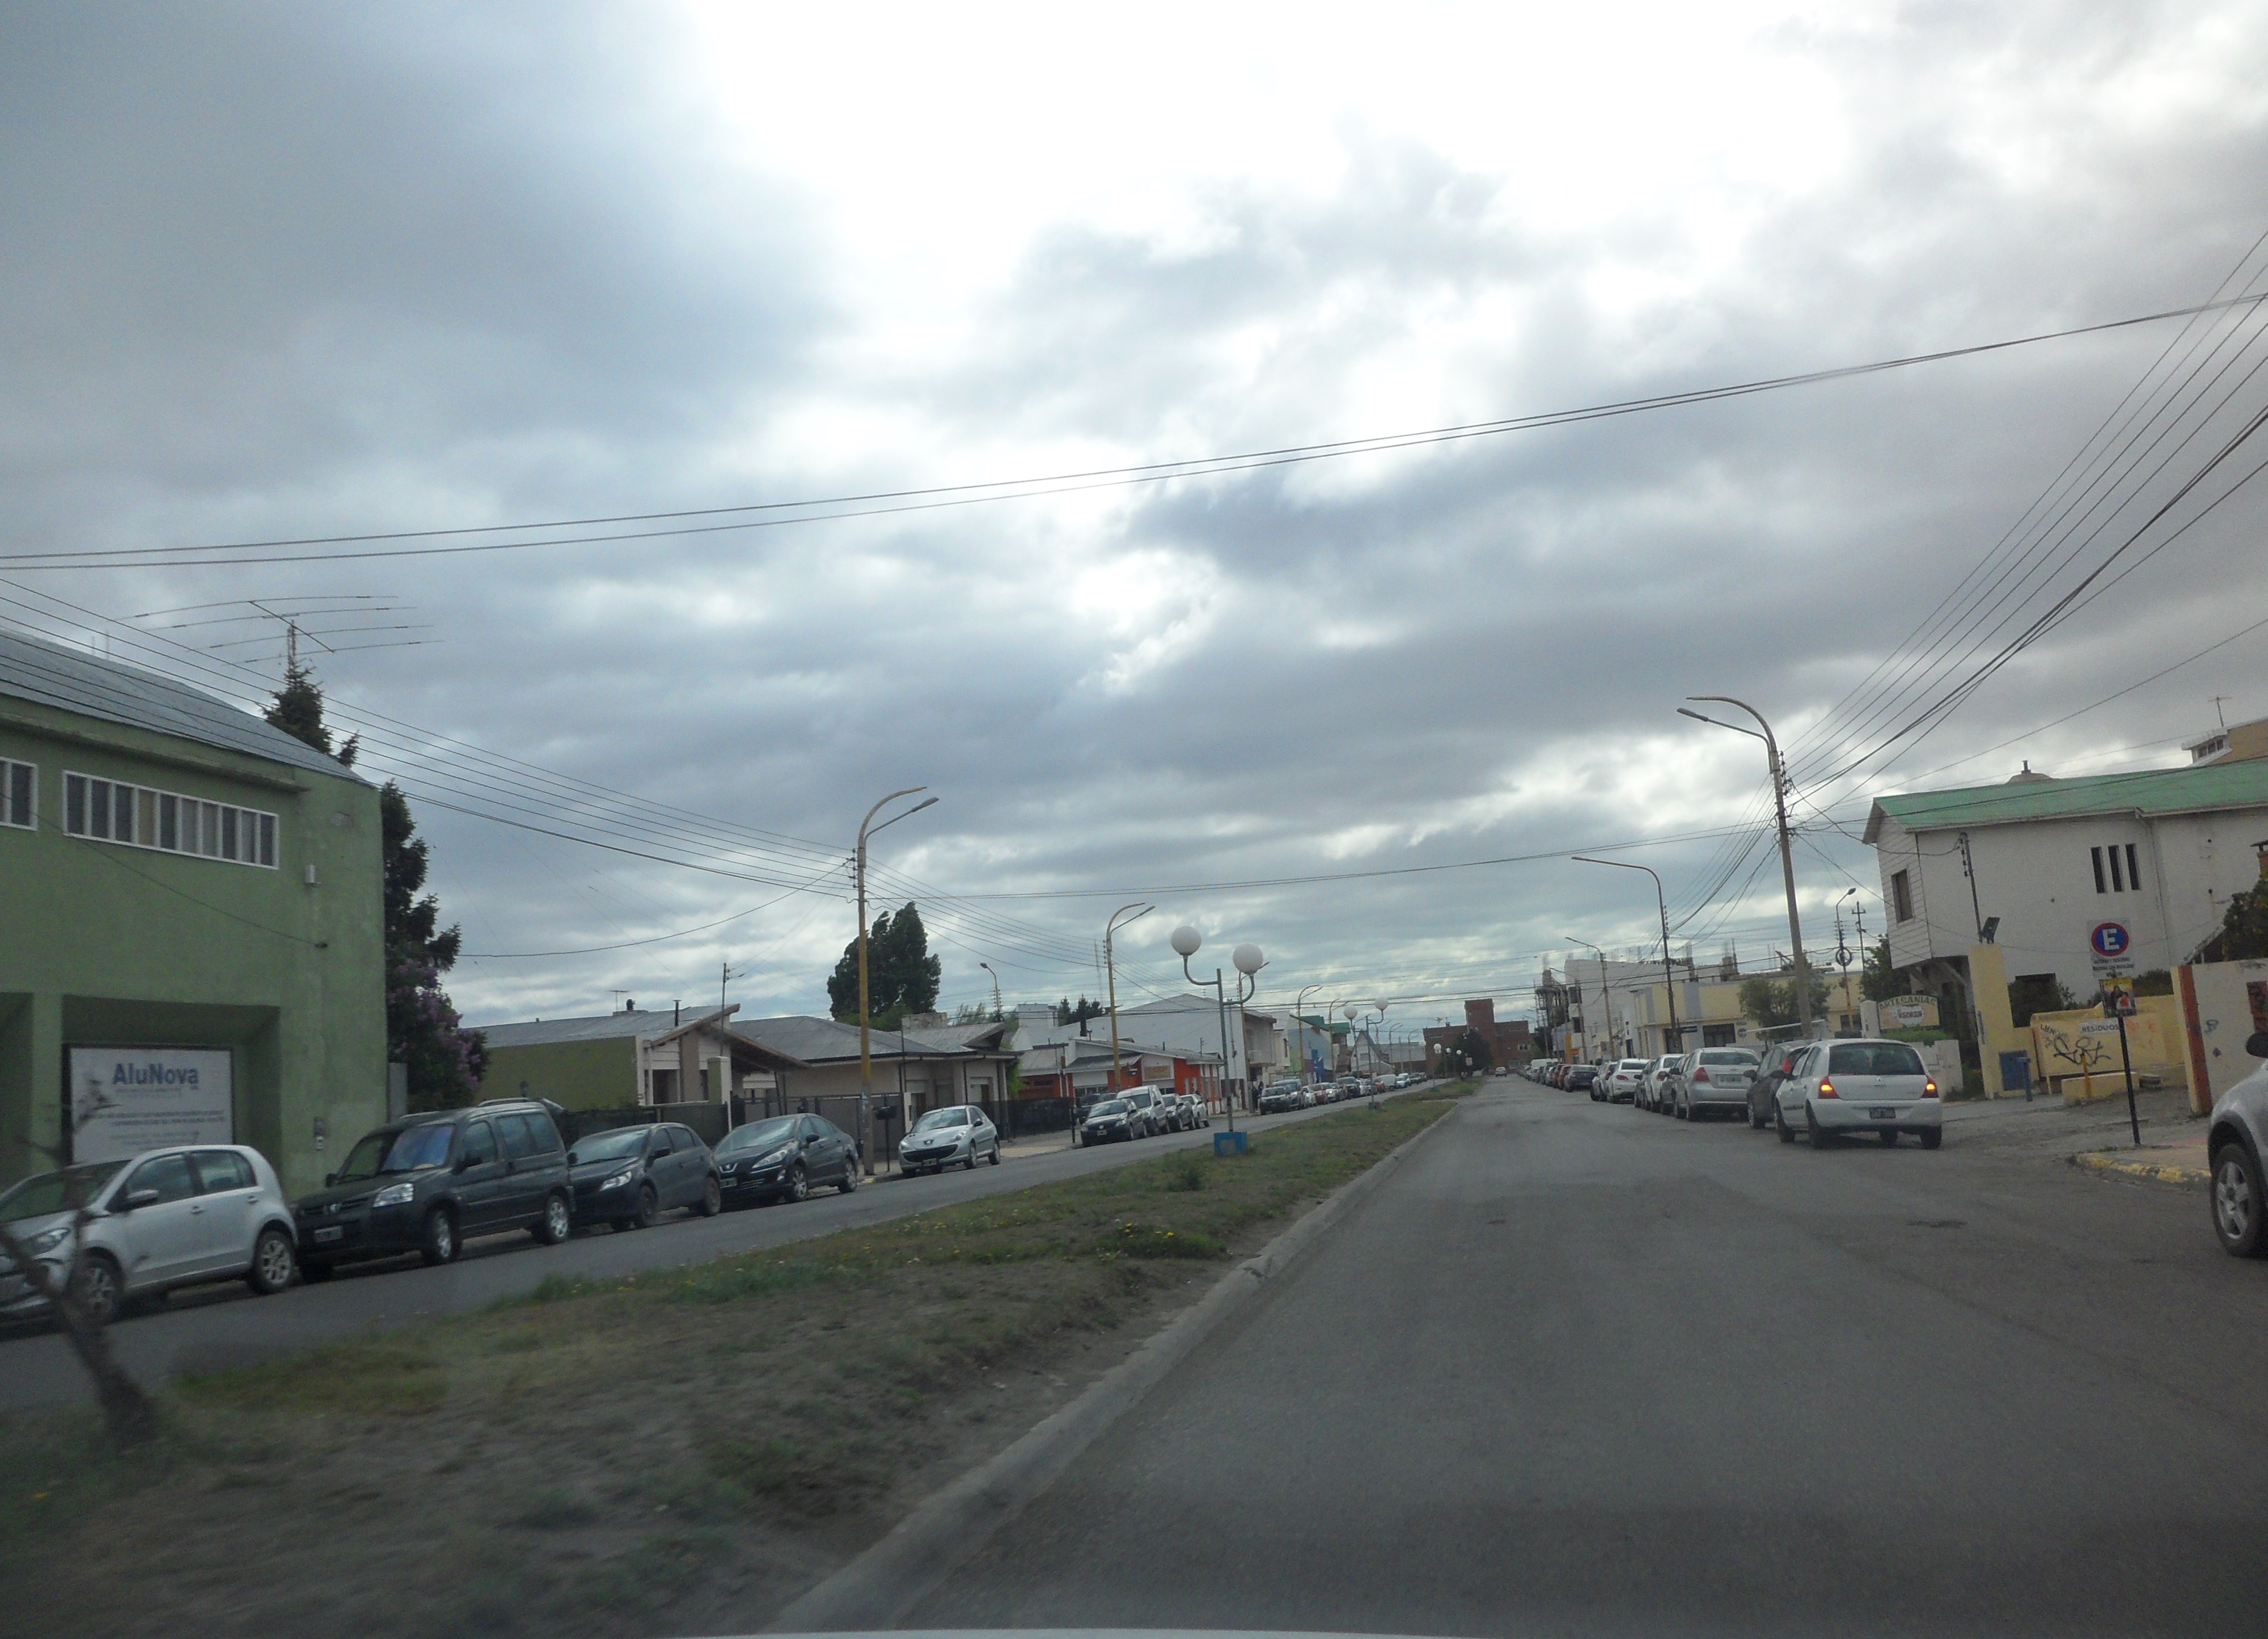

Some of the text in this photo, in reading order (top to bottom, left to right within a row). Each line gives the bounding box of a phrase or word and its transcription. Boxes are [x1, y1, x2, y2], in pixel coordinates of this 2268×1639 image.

[2102, 928, 2119, 951] E
[2081, 1024, 2119, 1033] RESIDUOS
[112, 1062, 199, 1085] AluNova
